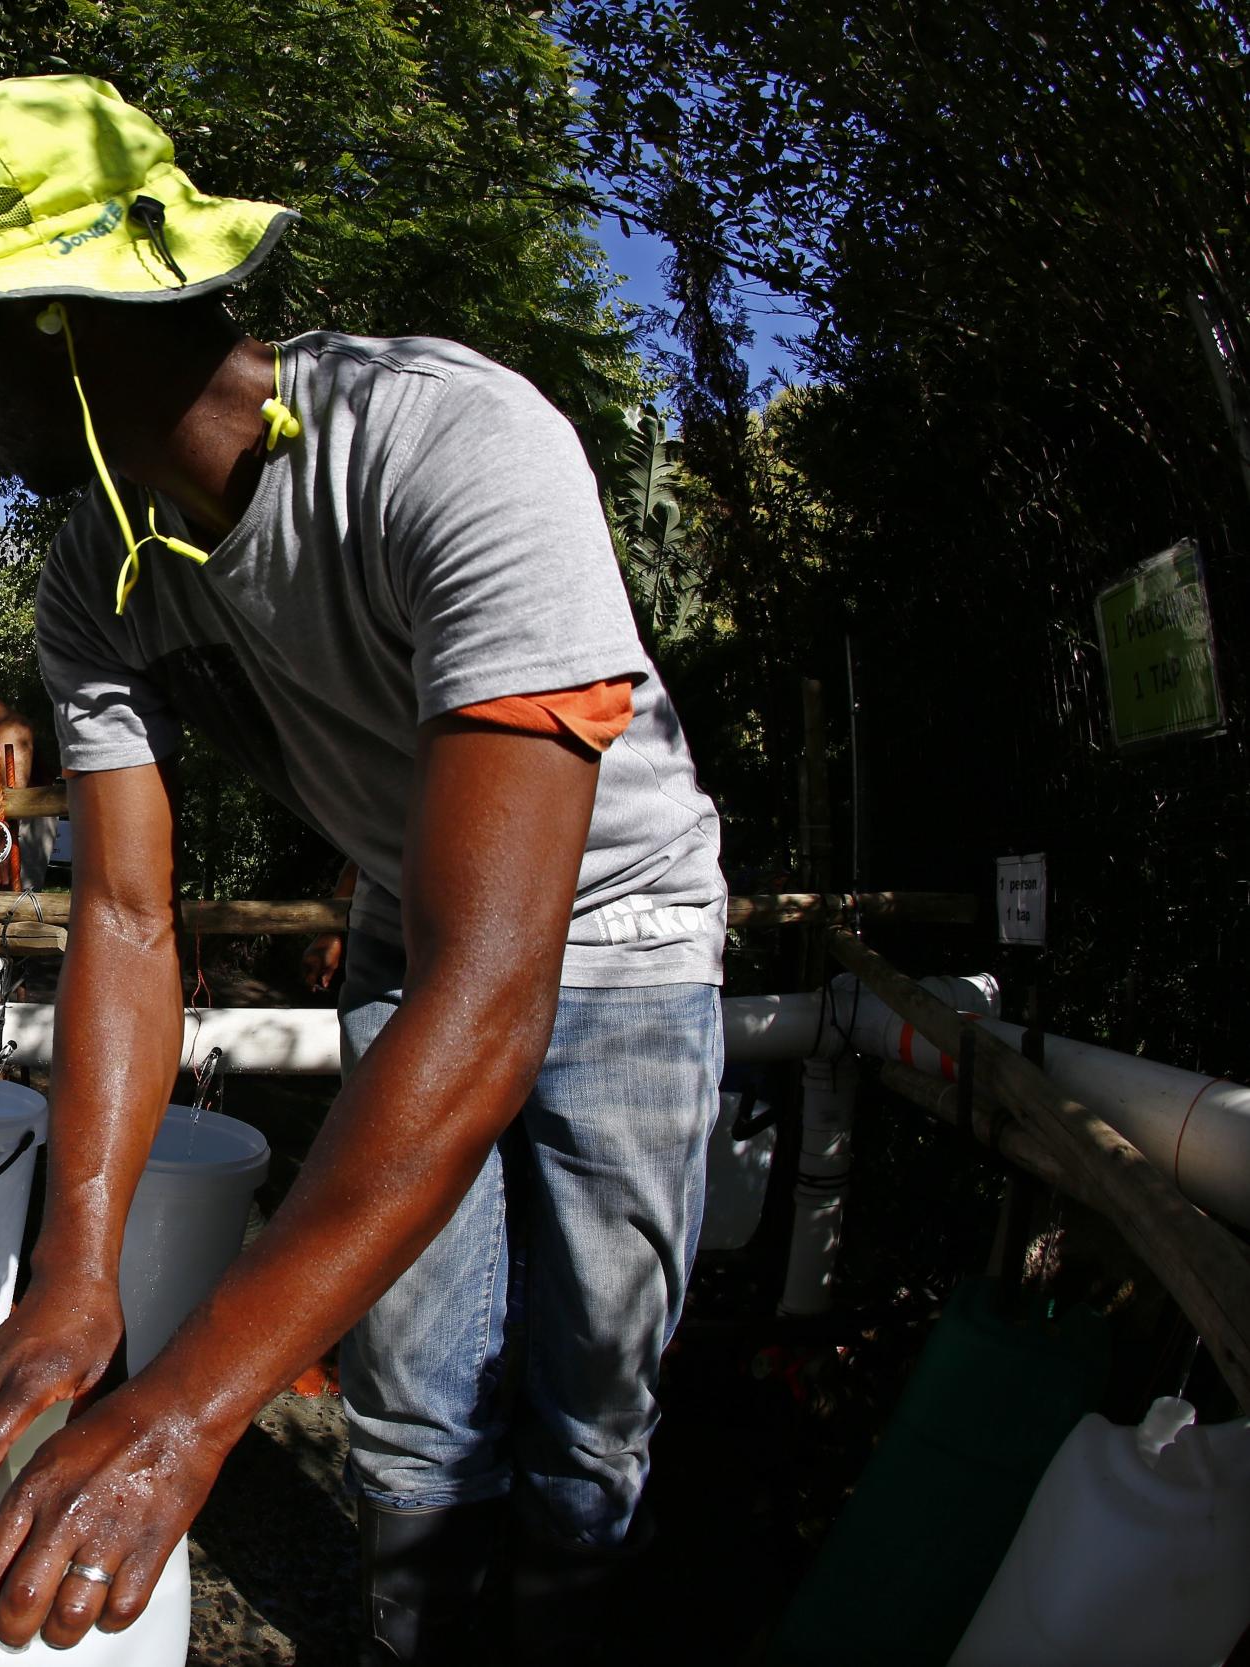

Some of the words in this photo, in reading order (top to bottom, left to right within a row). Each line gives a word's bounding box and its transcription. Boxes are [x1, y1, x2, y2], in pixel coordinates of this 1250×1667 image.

[1110, 621, 1121, 649] 1
[1133, 671, 1144, 700] 1
[1148, 656, 1182, 695] TAP
[1009, 878, 1038, 895] person
[1016, 908, 1031, 925] tap
